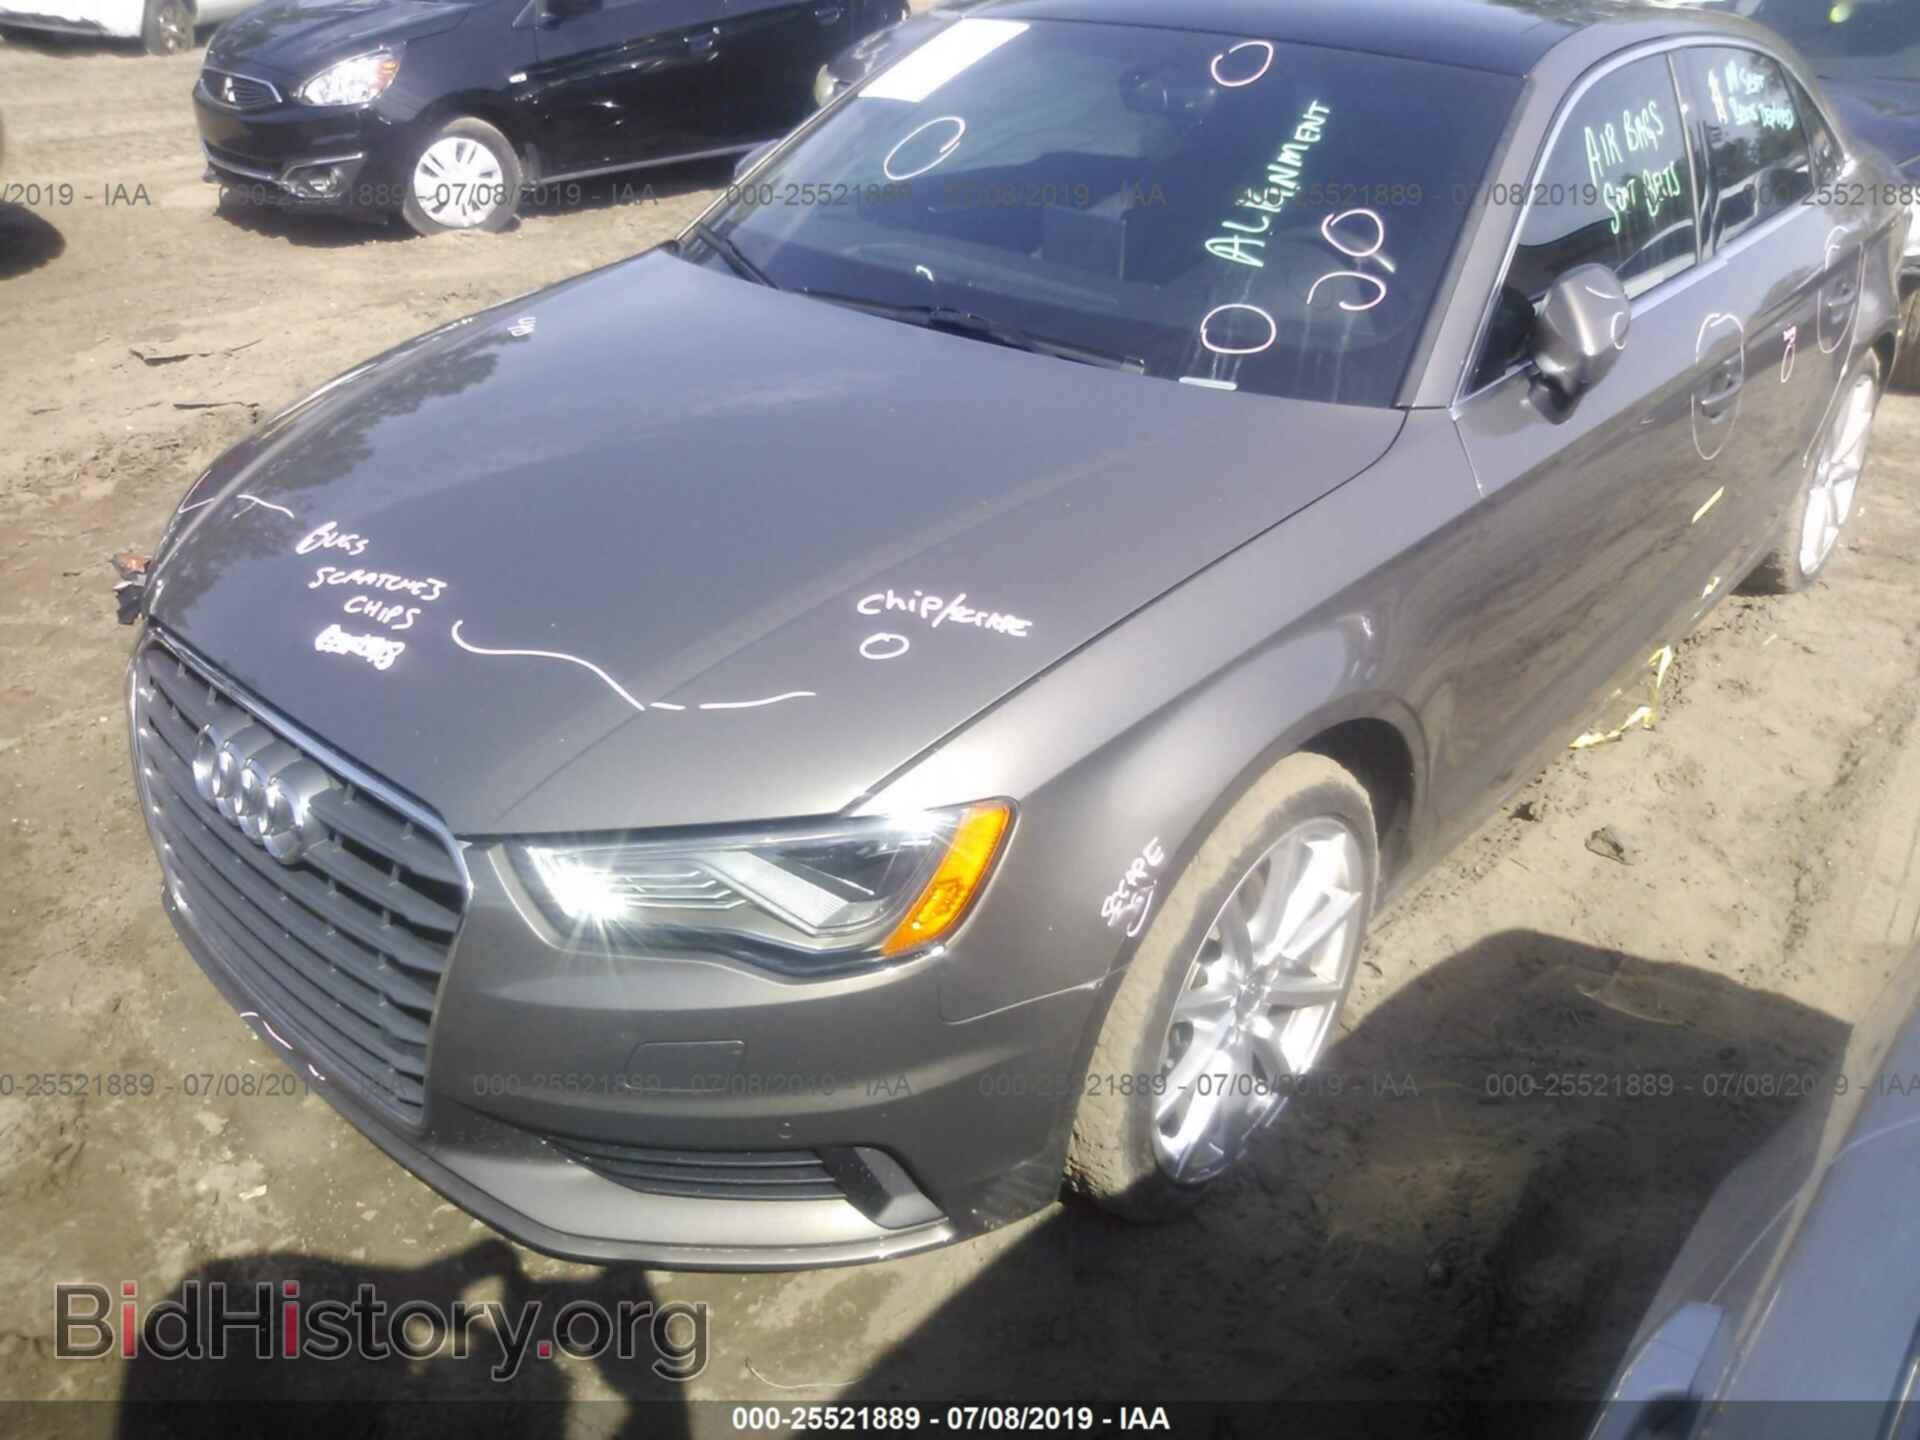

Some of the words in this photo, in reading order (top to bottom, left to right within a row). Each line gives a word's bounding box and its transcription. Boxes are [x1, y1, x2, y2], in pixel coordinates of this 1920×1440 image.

[1584, 125, 1623, 190] AIR
[1623, 100, 1665, 151] BAGS
[344, 596, 421, 630] CHIPS
